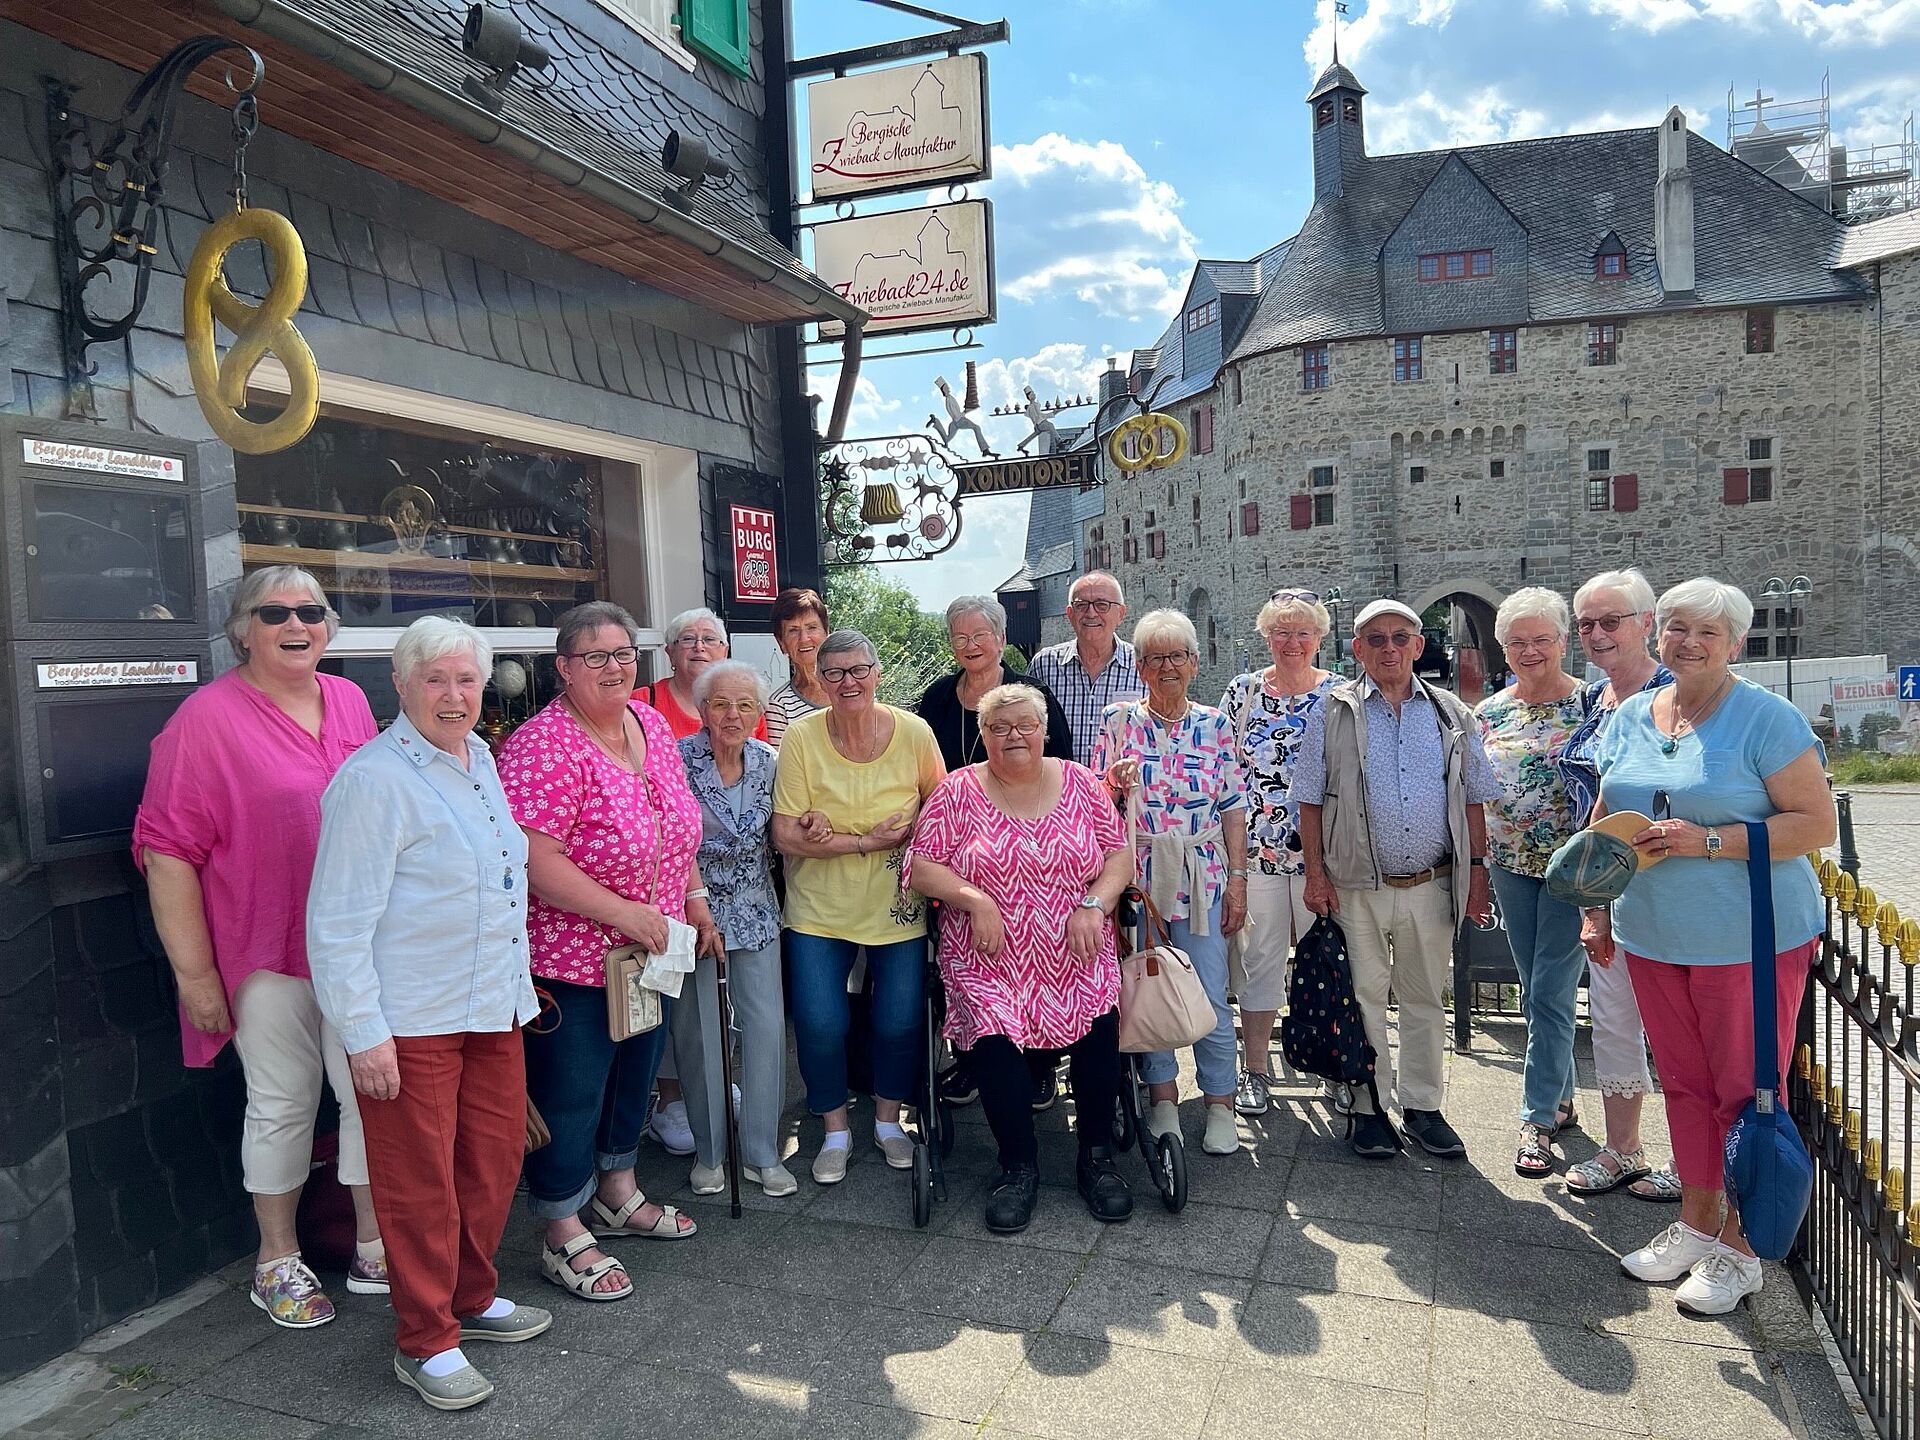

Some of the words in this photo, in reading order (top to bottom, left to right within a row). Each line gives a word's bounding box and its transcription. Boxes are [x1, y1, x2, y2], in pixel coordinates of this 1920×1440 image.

[851, 118, 912, 147] Bergische
[812, 138, 880, 174] Zwieback
[883, 136, 957, 160] Manufaktur
[868, 303, 900, 314] Bergische
[902, 299, 933, 310] Zwieback
[33, 441, 103, 461] Bergisches
[108, 450, 162, 469] Landbier
[39, 456, 76, 467] Traditionell
[738, 529, 772, 550] BURG
[751, 560, 769, 576] POP
[47, 663, 118, 680] Bergisches
[121, 661, 176, 677] Landbier
[54, 678, 90, 687] Traditionell
[1844, 681, 1885, 699] ZEDLER
